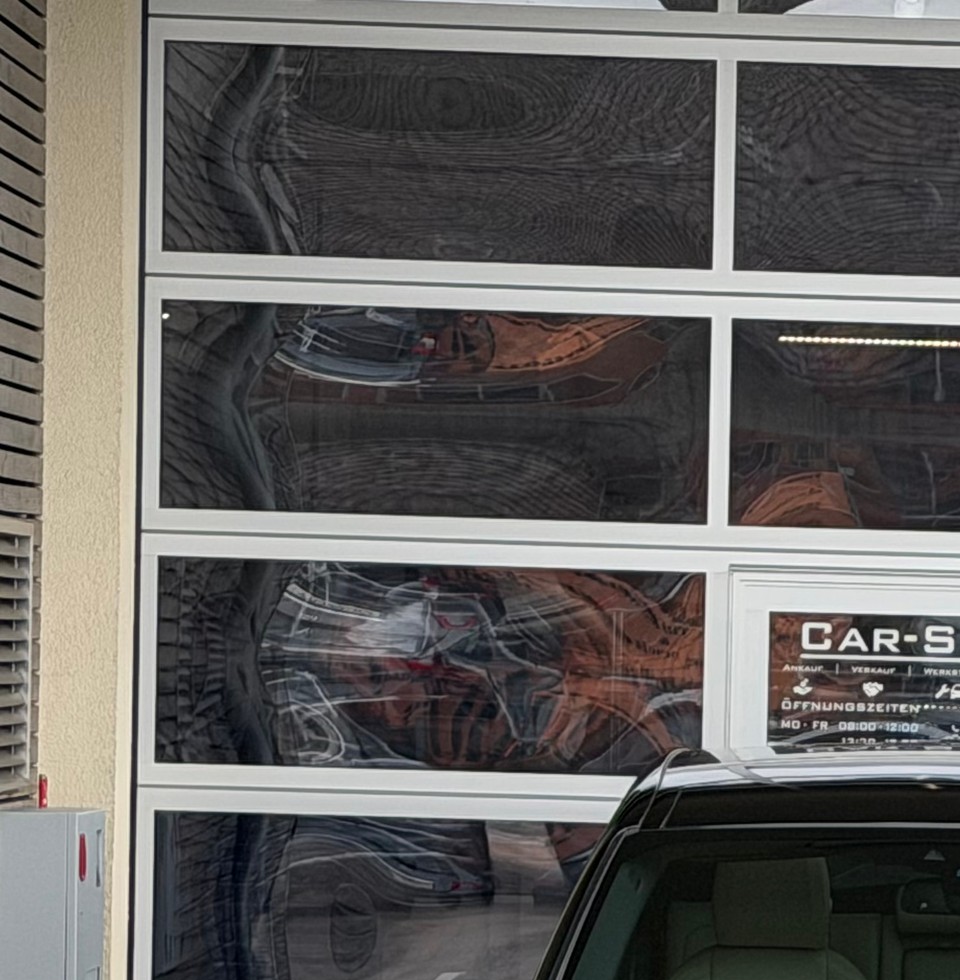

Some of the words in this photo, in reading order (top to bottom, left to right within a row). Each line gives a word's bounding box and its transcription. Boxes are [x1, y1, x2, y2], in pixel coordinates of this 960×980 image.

[782, 663, 824, 673] ANKAUF
[851, 666, 897, 675] VERKAUF
[781, 697, 920, 714] ÖFFNUNGSZEITEN
[781, 719, 801, 730] MO
[812, 720, 829, 732] FR
